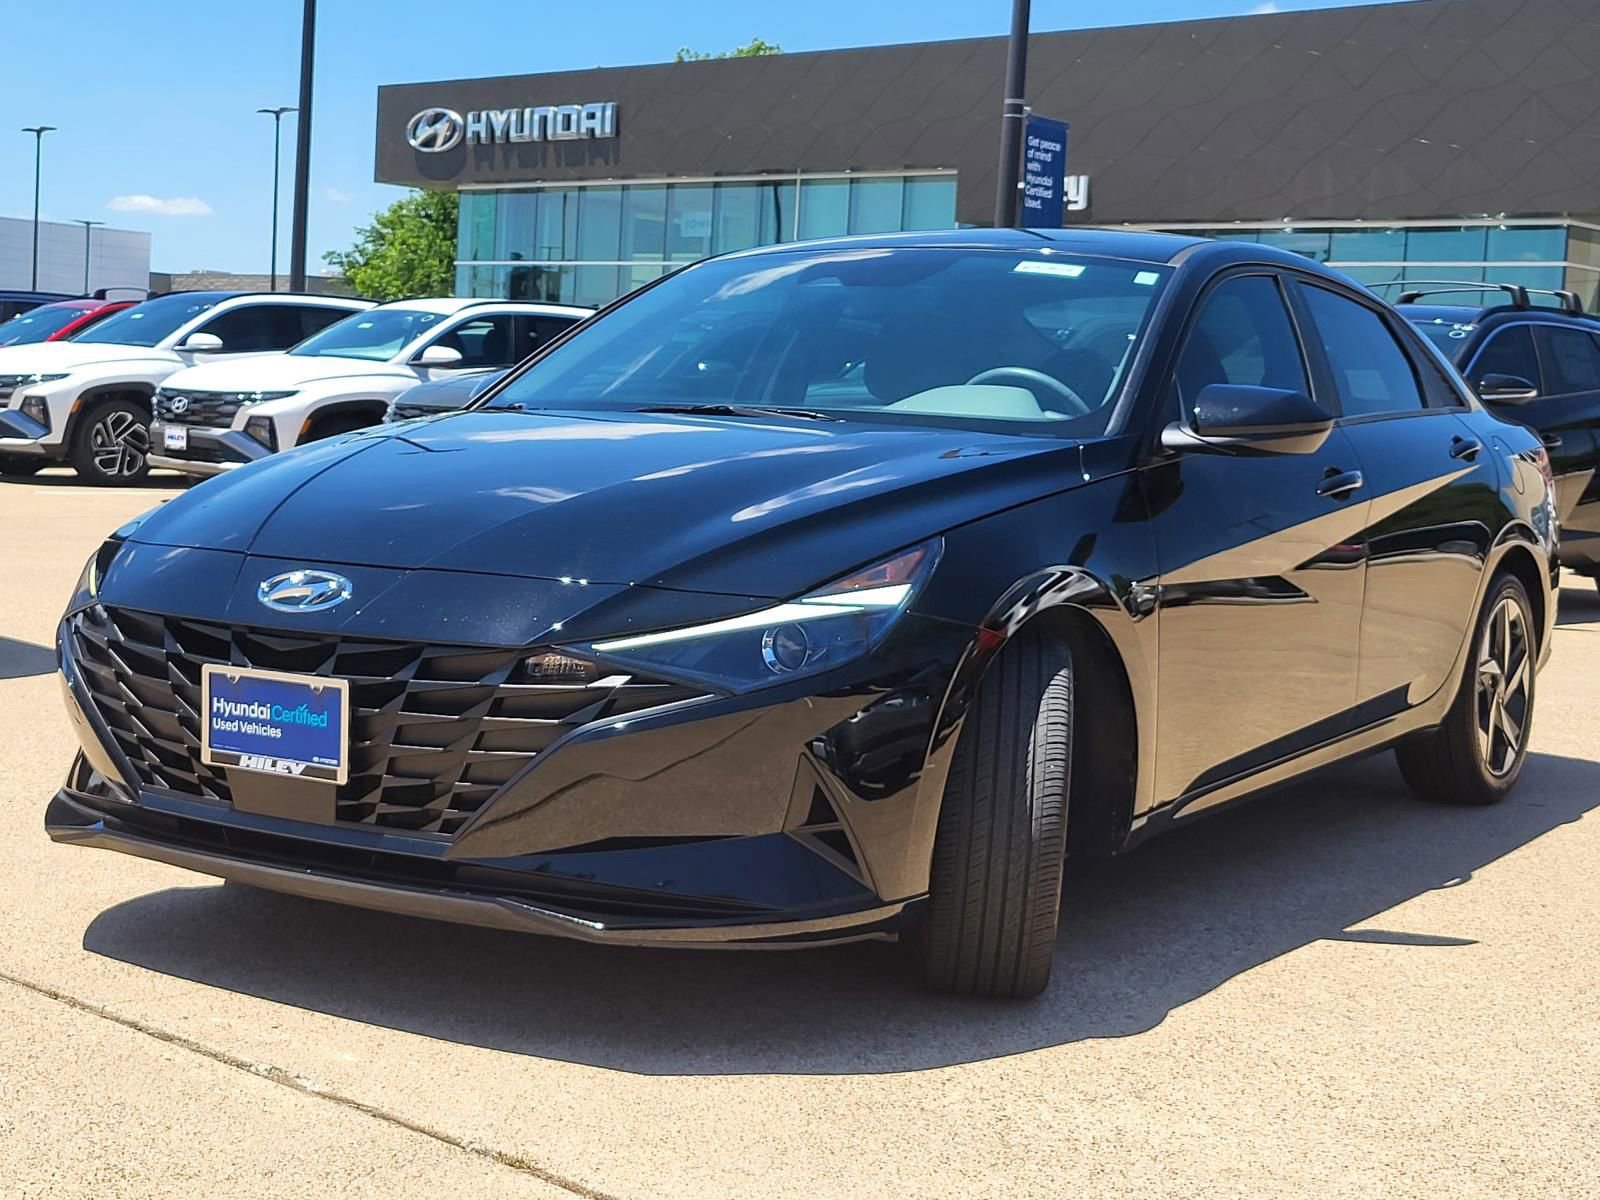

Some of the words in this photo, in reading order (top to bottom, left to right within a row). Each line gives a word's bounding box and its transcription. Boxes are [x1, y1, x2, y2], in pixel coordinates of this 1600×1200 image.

[466, 102, 617, 144] HYUNDAI
[1028, 136, 1040, 147] Get
[1040, 140, 1061, 152] peace
[1027, 149, 1034, 159] of
[1034, 151, 1051, 162] mind
[1027, 161, 1041, 172] with
[1026, 173, 1053, 187] Hyundai
[1025, 185, 1053, 199] Certified
[213, 697, 271, 720] Hyundai
[271, 704, 328, 727] Certified
[213, 717, 239, 732] Used
[240, 721, 282, 738] Vehicles
[239, 755, 307, 775] HILEY
